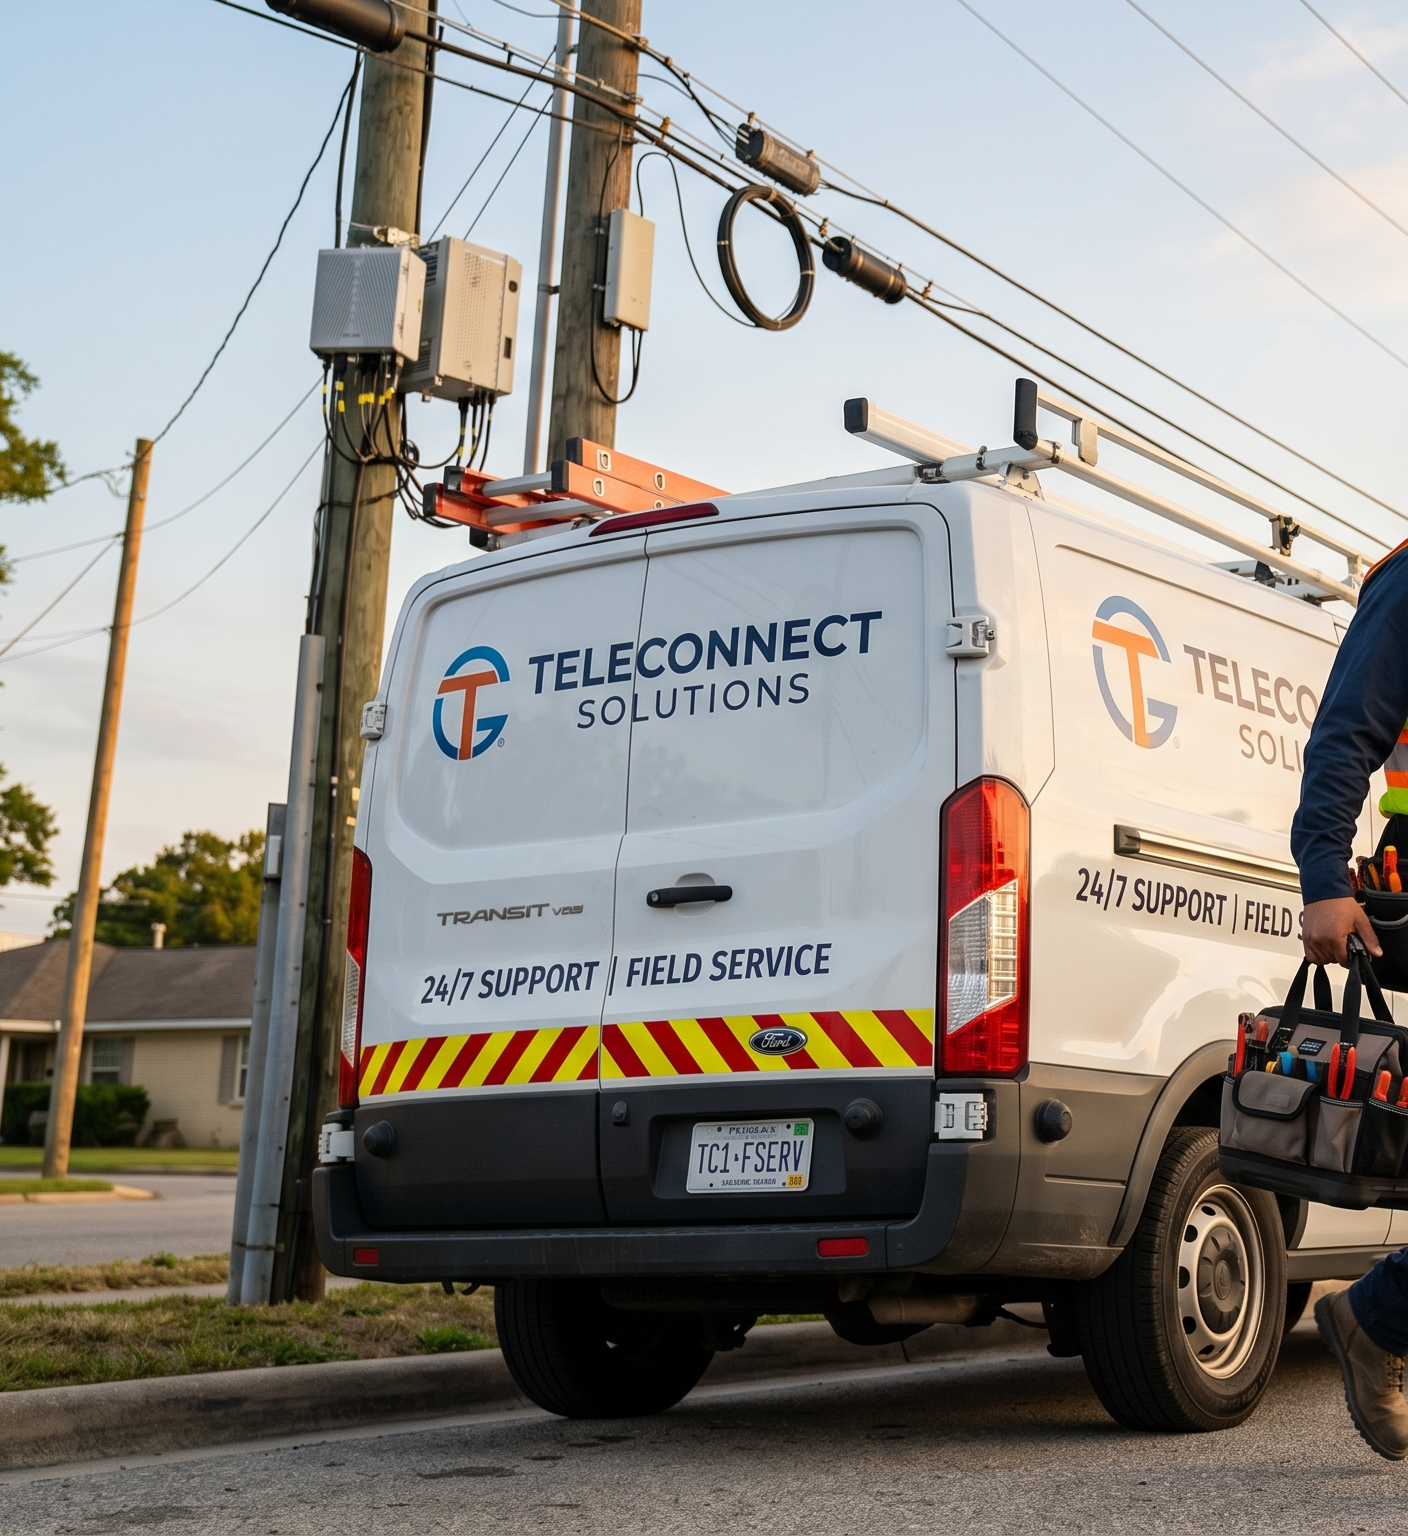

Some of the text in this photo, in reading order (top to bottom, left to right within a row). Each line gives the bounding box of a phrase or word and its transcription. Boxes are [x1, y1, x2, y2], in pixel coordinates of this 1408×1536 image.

[528, 611, 883, 694] TELECONNECT
[576, 673, 810, 729] SOLUTIONS
[1183, 643, 1319, 730] TELECO
[436, 902, 550, 926] TRANSIT
[1076, 867, 1128, 911] 24/7
[1131, 878, 1228, 926] SUPPORT
[1244, 900, 1293, 938] FIELD
[420, 968, 475, 1006] 24/7
[477, 961, 601, 999] SUPPORT
[626, 953, 703, 988] FIELD
[708, 943, 833, 982] SERVICE
